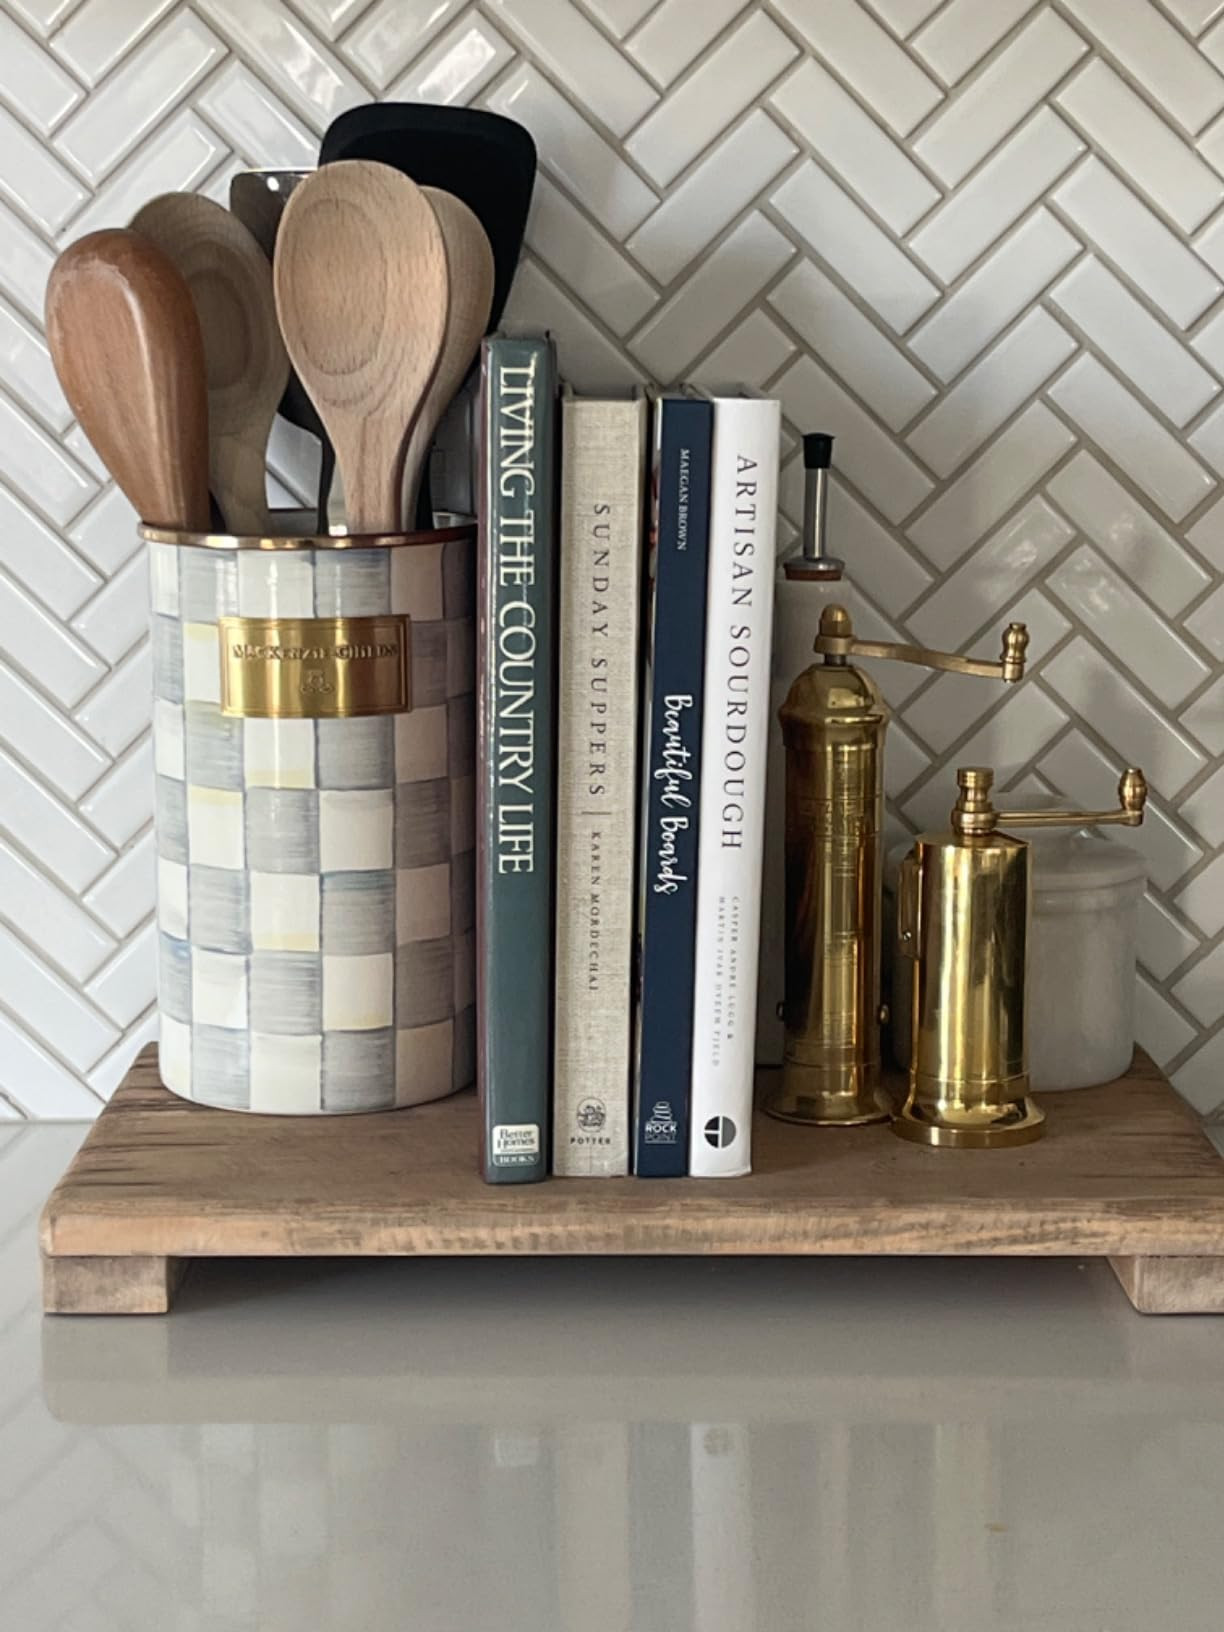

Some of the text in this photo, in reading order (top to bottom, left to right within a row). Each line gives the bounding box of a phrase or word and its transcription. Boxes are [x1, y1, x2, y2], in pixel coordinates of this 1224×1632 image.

[676, 448, 690, 551] MAEGAN BROWN
[498, 356, 537, 874] LIVING THE COUNTRY LIFE
[588, 504, 609, 795] SUNDAY SUPPERS
[722, 455, 758, 849] ARTISAN SOURDOUGH
[653, 694, 693, 895] Beautiful Boards
[588, 831, 602, 992] KAREN MORDECHAI
[717, 896, 726, 943] MARTIN
[730, 896, 740, 943] CASPER
[570, 1137, 611, 1145] POTTER
[646, 1124, 677, 1133] ROCK
